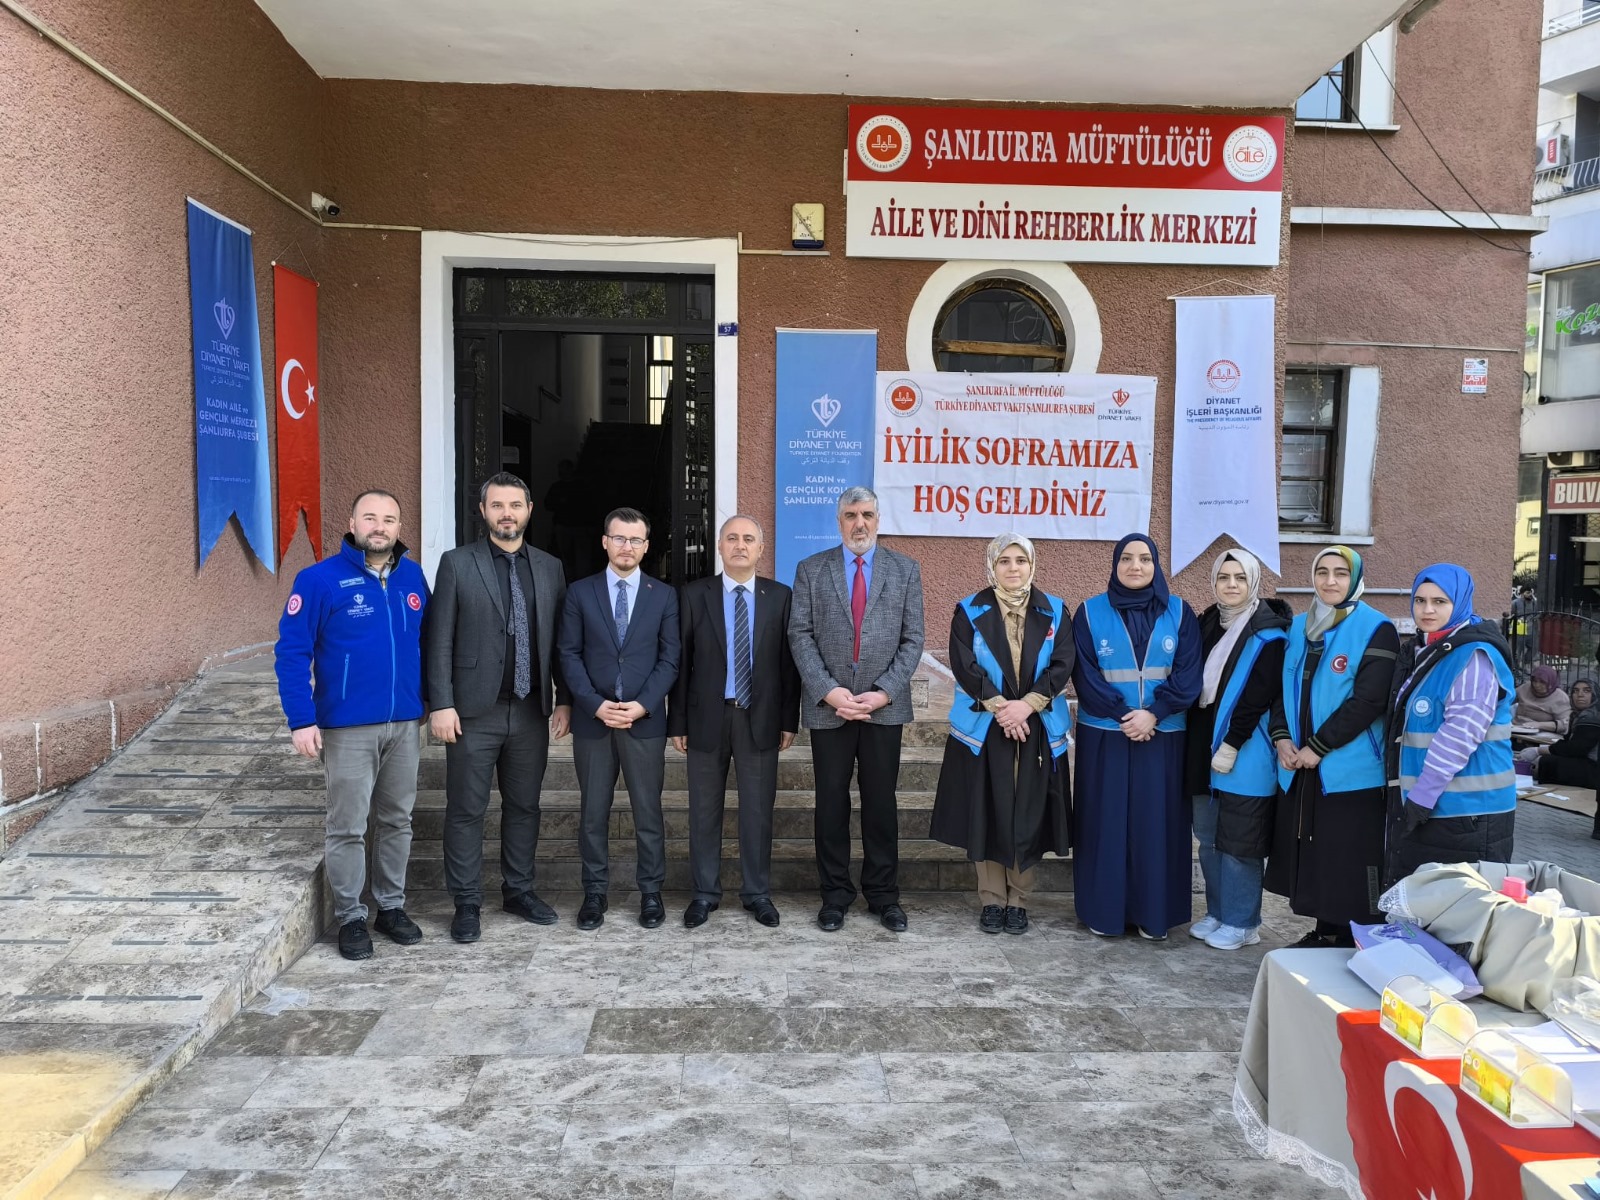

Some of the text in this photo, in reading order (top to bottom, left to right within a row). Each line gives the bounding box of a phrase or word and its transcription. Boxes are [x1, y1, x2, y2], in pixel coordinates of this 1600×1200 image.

[924, 128, 1057, 169] ŞANLIURFA
[1066, 124, 1212, 167] MÜFTÜLÜĞÜ
[871, 198, 1258, 245] AİLE VE DİNİ REHBERLİK MERKEZİ
[211, 339, 240, 357] TÜRKİYE
[200, 350, 250, 373] DİYANET VAKFI
[966, 384, 1066, 398] ŞANLIURFA İL MÜFTÜLÜĞÜ
[206, 397, 228, 410] KADIN
[935, 398, 1096, 416] TÜRKİYE DİYANET VAKFI ŞANLIURFA ŞUBESİ
[1206, 396, 1241, 405] DİYANET
[1186, 405, 1262, 418] İŞLERİ BAŞKANLIĞI
[199, 410, 258, 429] GENÇLİK MERKEZİ
[199, 424, 236, 438] ŞANLIURFA
[805, 429, 847, 438] TÜRKİYE
[789, 438, 862, 449] DİYANET VAKFI
[883, 426, 1140, 469] İYİLİK SOFRAMIZA
[805, 475, 834, 483] KADIN
[785, 485, 825, 495] GENÇLİK
[784, 496, 834, 506] ŞANLIURFA
[913, 480, 1107, 522] HOŞ GELDİNİZ
